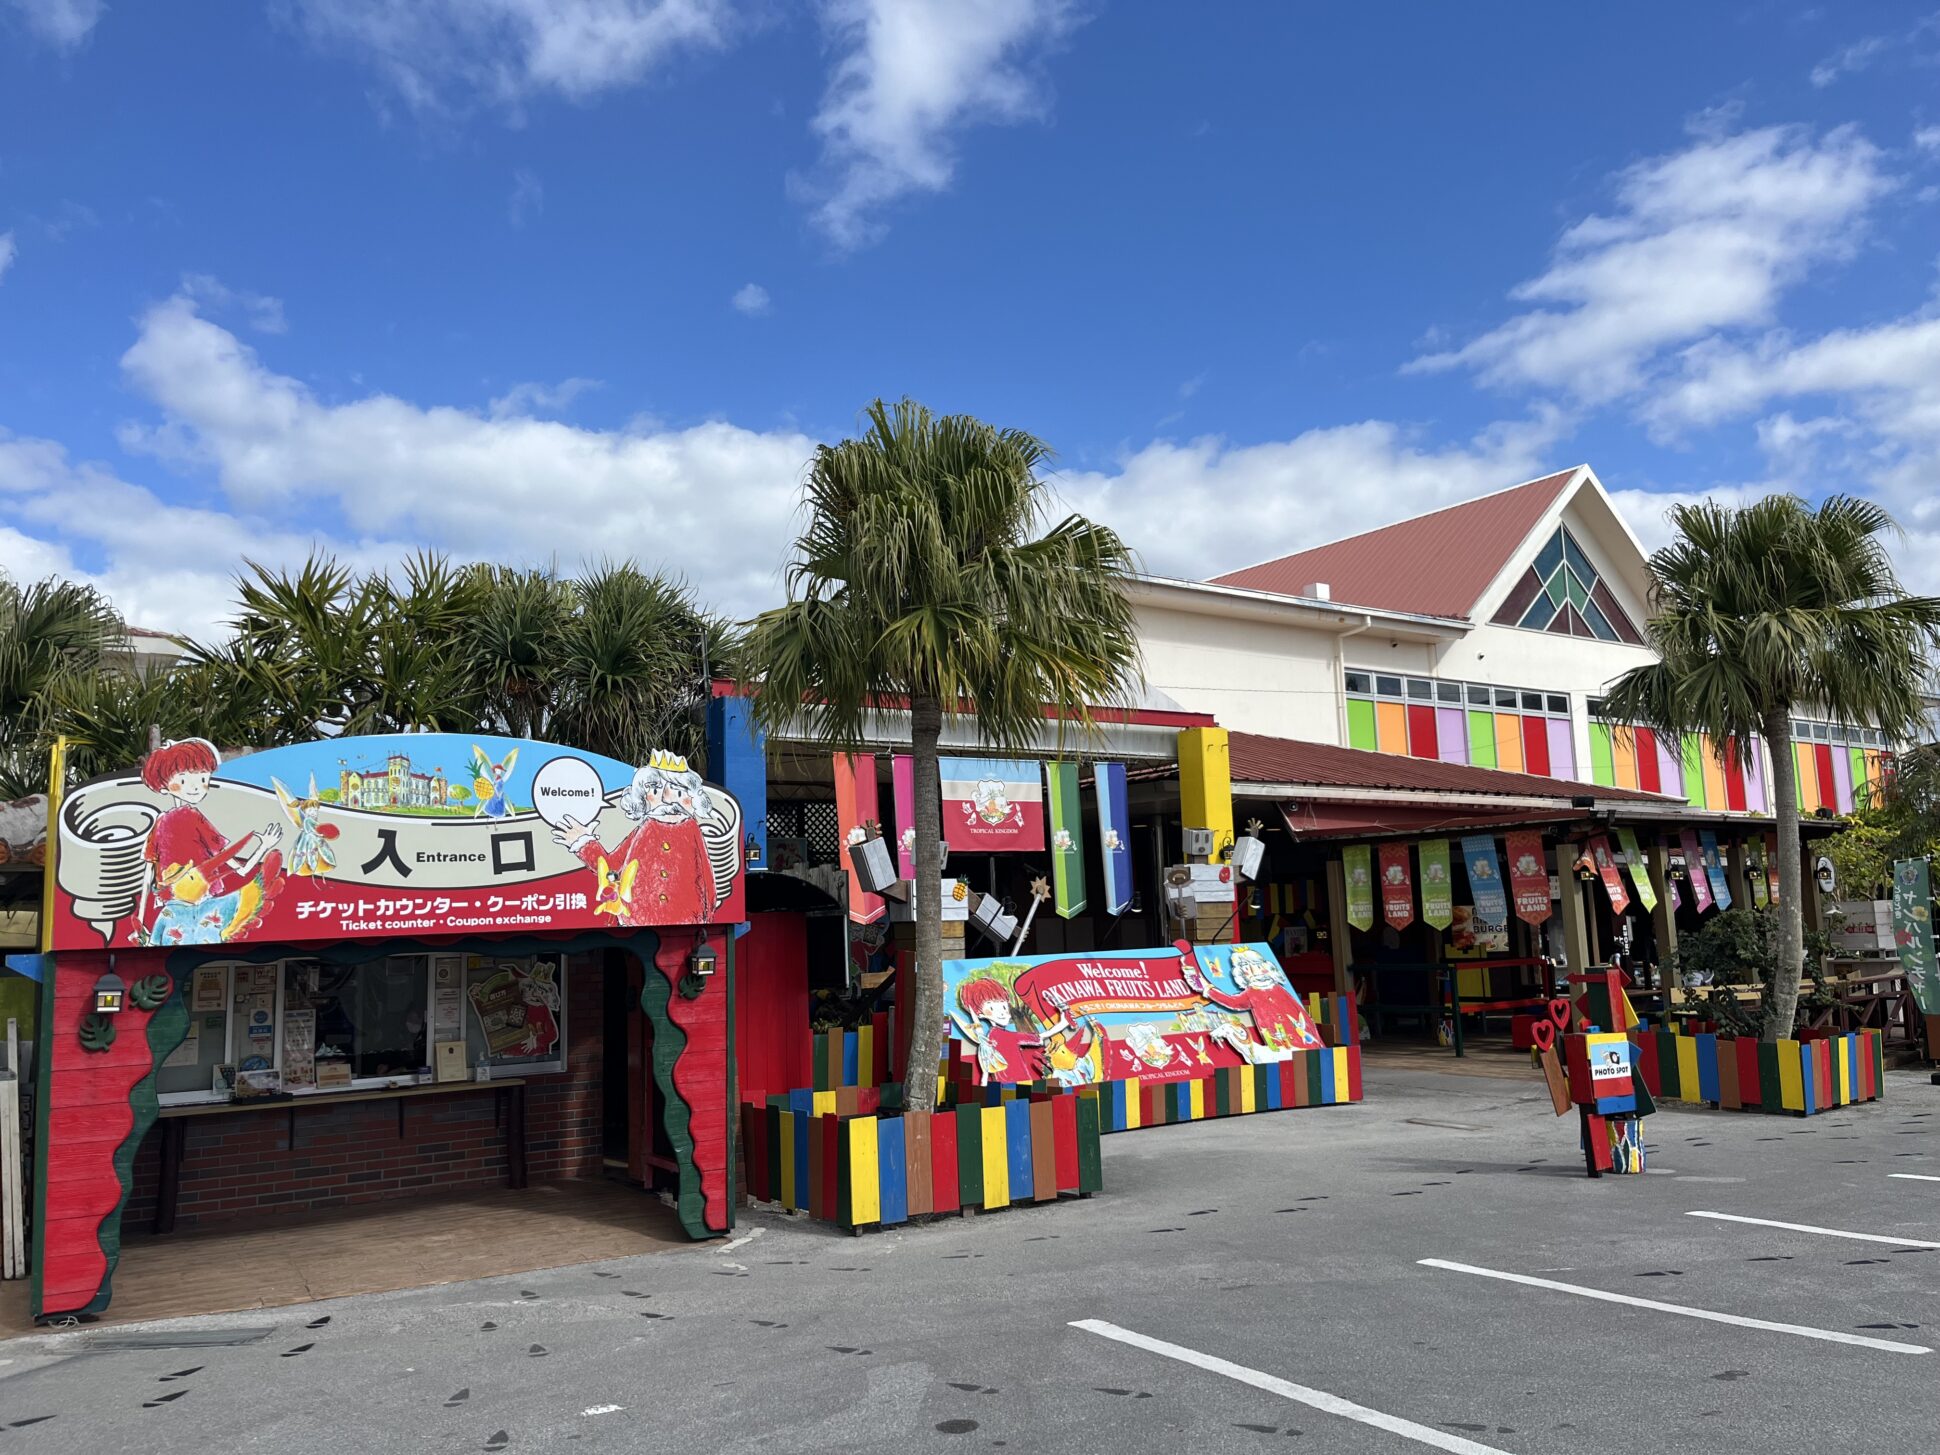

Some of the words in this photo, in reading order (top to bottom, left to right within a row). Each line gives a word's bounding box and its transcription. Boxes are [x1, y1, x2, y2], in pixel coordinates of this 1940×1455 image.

[540, 787, 595, 798] Welcome!
[416, 851, 487, 863] Entrance
[1517, 896, 1548, 905] FRUITS
[296, 893, 588, 920] チケットカウンター・クーポン引換
[1386, 903, 1410, 911] FRUITS
[1520, 904, 1547, 912] LAND
[340, 919, 383, 931] Ticket
[384, 917, 436, 930] counter
[447, 915, 494, 927] Coupon
[495, 913, 552, 926] exchange
[1076, 961, 1150, 979] Welcome!
[1042, 980, 1106, 1007] OKINAWA
[1104, 979, 1155, 999] FRUITS
[1154, 978, 1191, 998] LAND
[1138, 1072, 1165, 1080] TROPICAL
[1165, 1069, 1190, 1078] KINGDOM
[1594, 1067, 1615, 1076] PHOTO
[1616, 1066, 1629, 1075] SPOT
